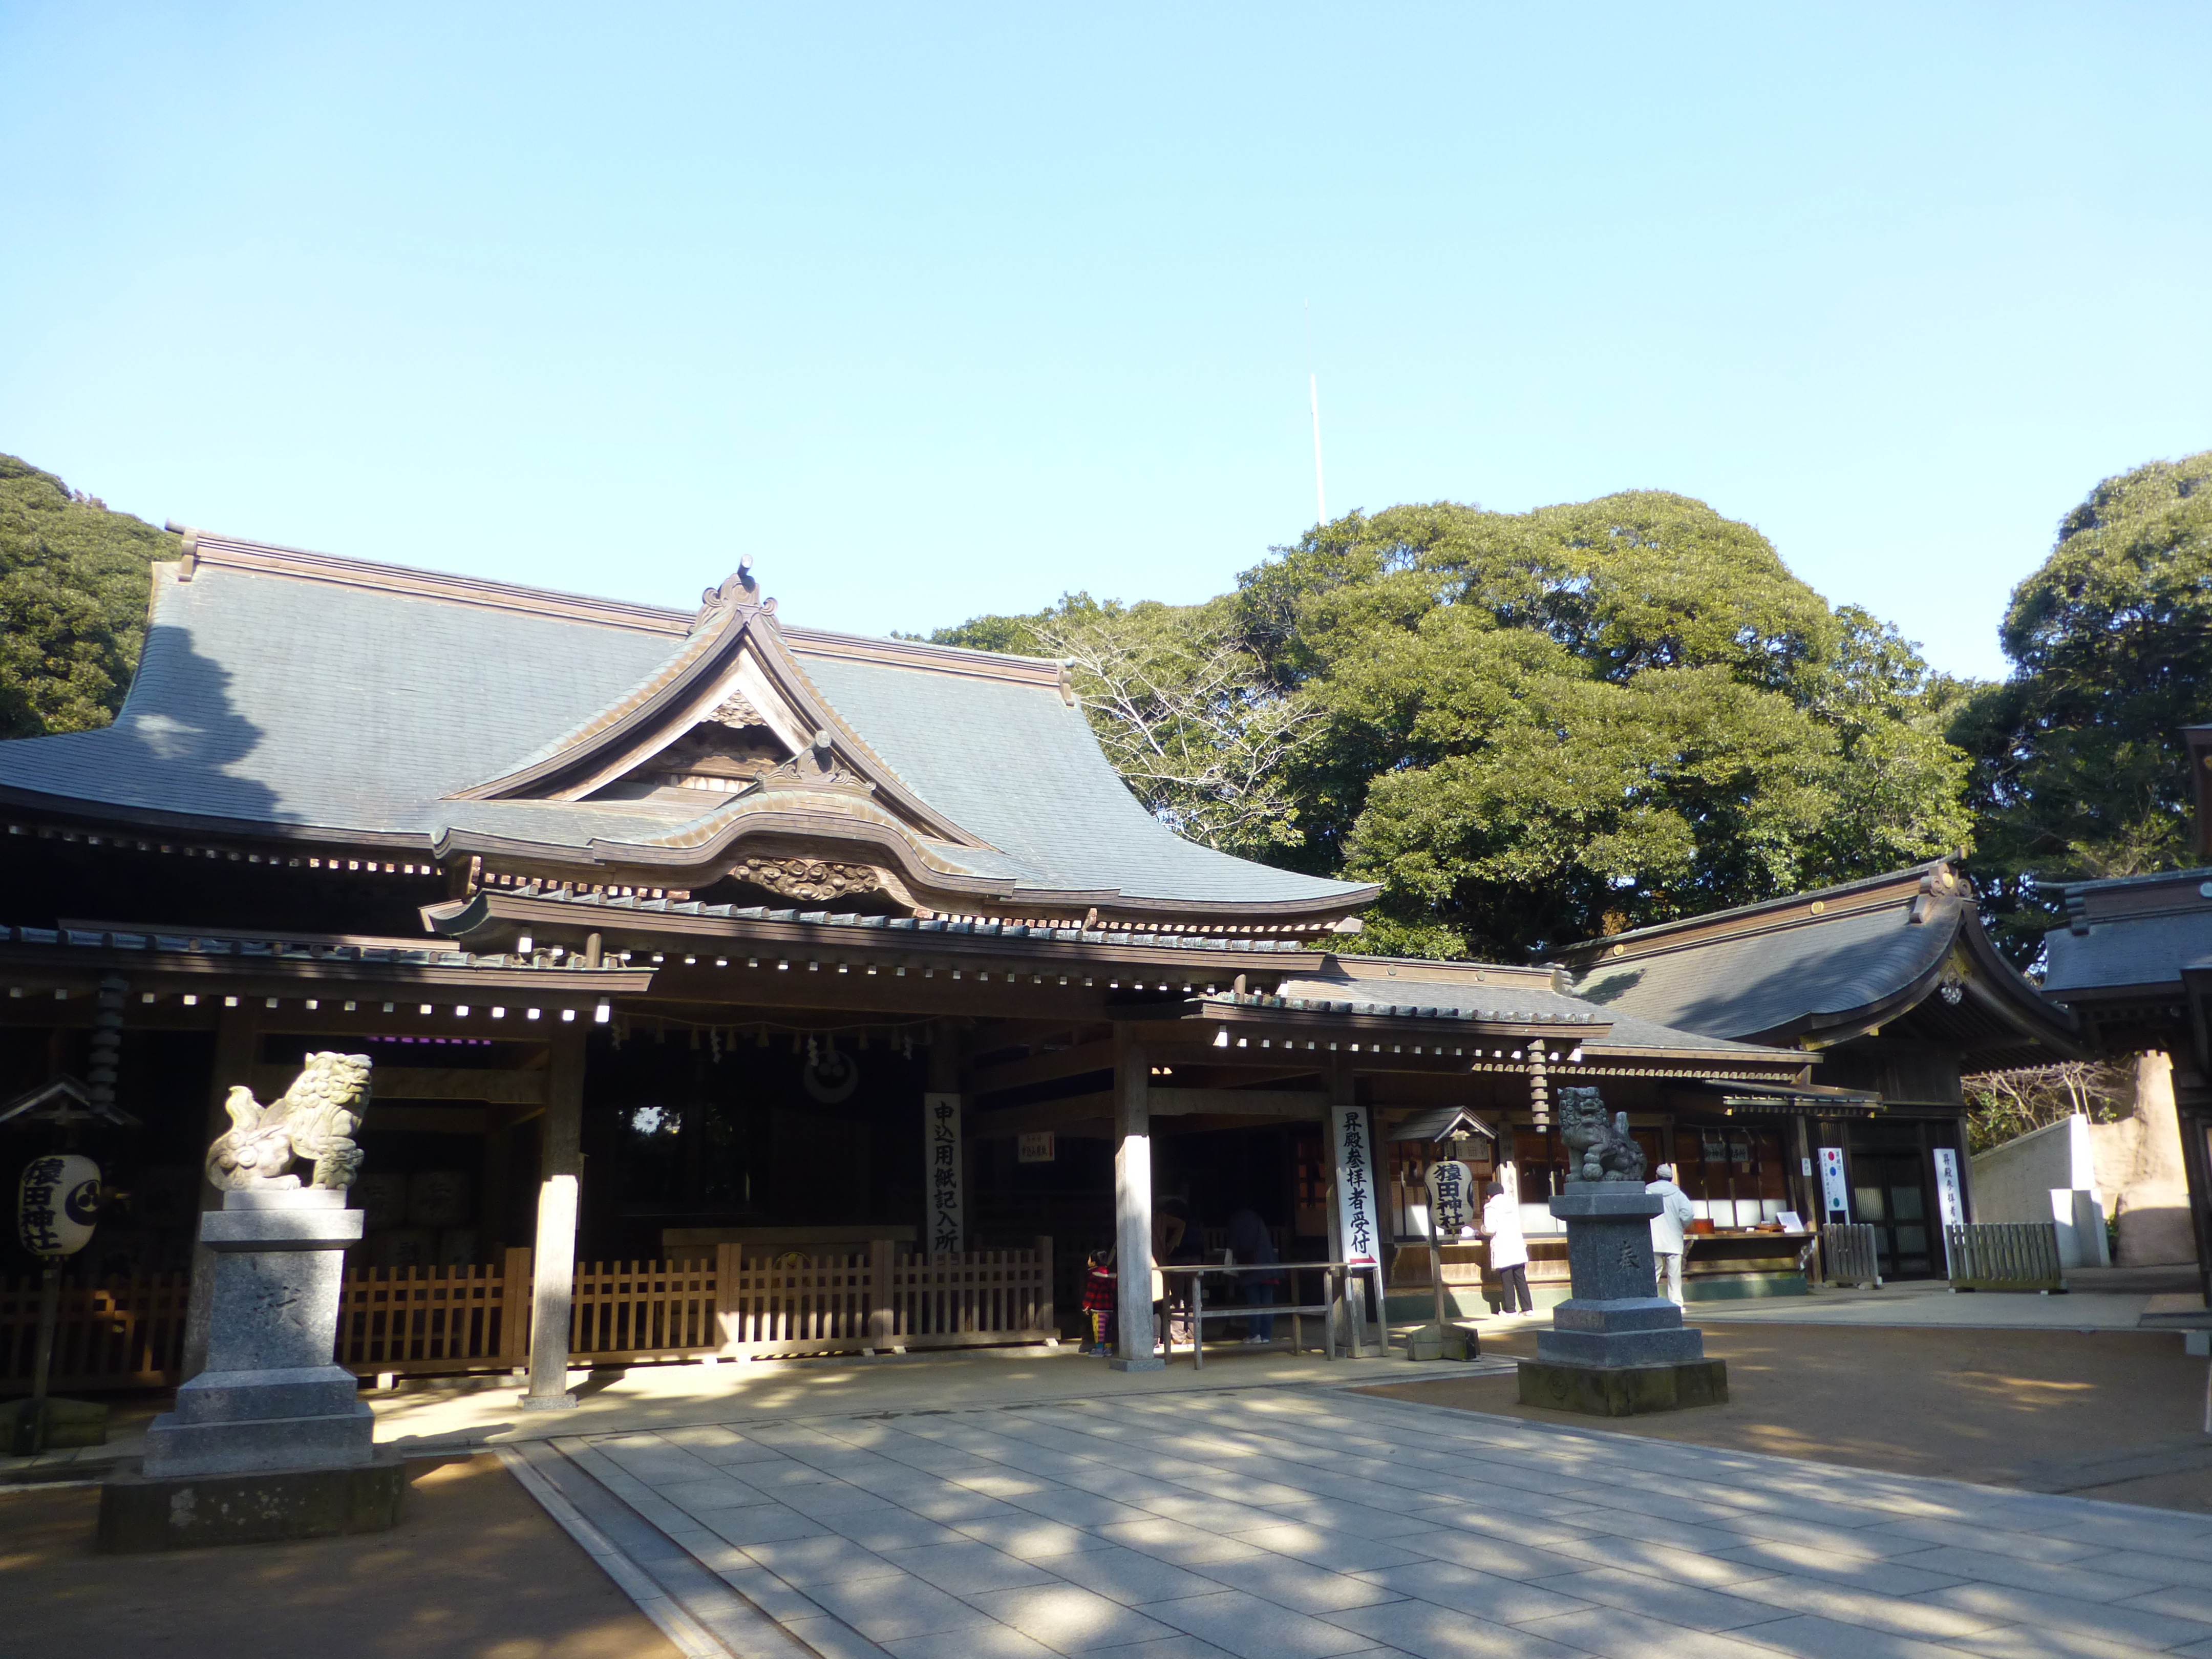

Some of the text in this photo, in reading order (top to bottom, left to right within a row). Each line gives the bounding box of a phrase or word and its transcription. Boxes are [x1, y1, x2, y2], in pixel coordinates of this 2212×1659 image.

[21, 1158, 65, 1251] 猿田神社
[934, 1101, 959, 1252] 申込用紙記入所
[1342, 1112, 1371, 1253] 昇殿参拝者受付
[1433, 1163, 1465, 1228] 猿田神社
